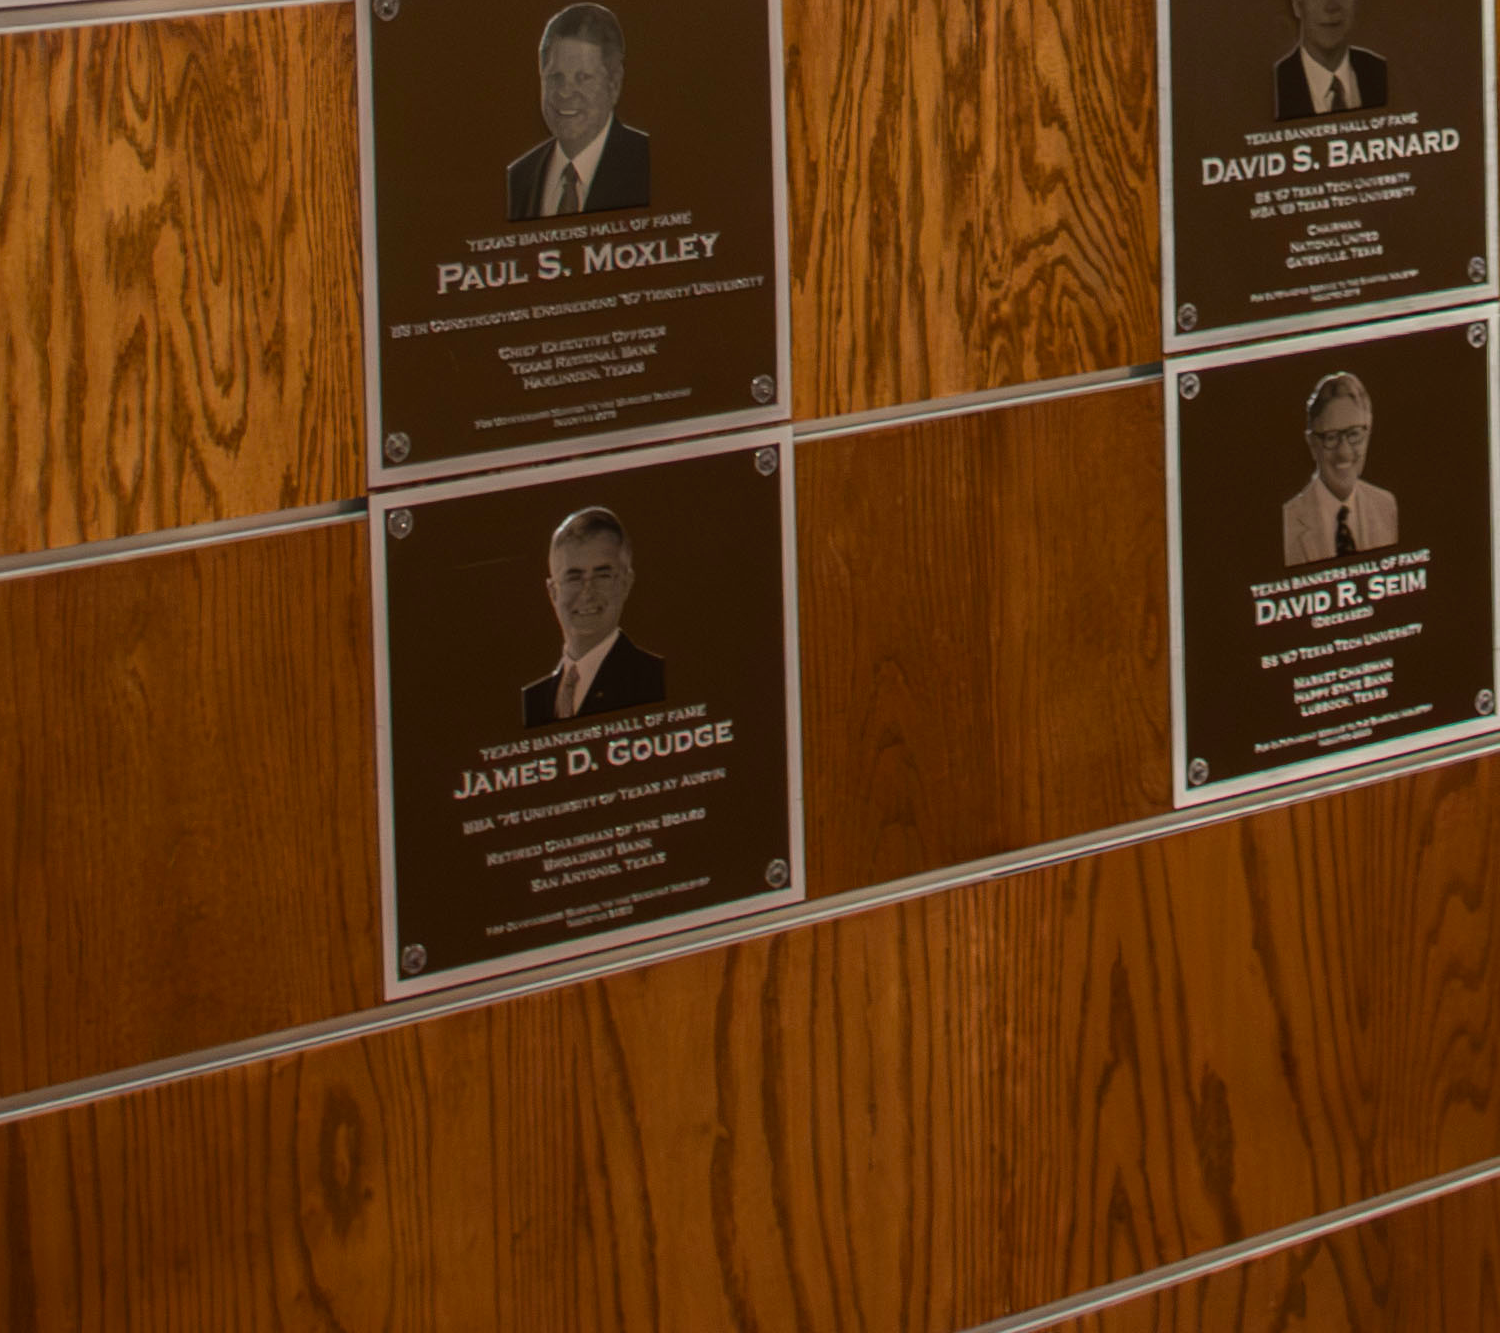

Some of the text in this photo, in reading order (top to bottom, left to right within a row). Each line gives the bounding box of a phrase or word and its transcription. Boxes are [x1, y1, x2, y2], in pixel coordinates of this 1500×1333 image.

[1202, 129, 1459, 185] DAVID S. BARNARD
[438, 233, 718, 294] PAUL S. MOXLEY
[1256, 569, 1426, 625] DAVID R. SEIM
[454, 720, 733, 799] JAMES D. GOUDGE
